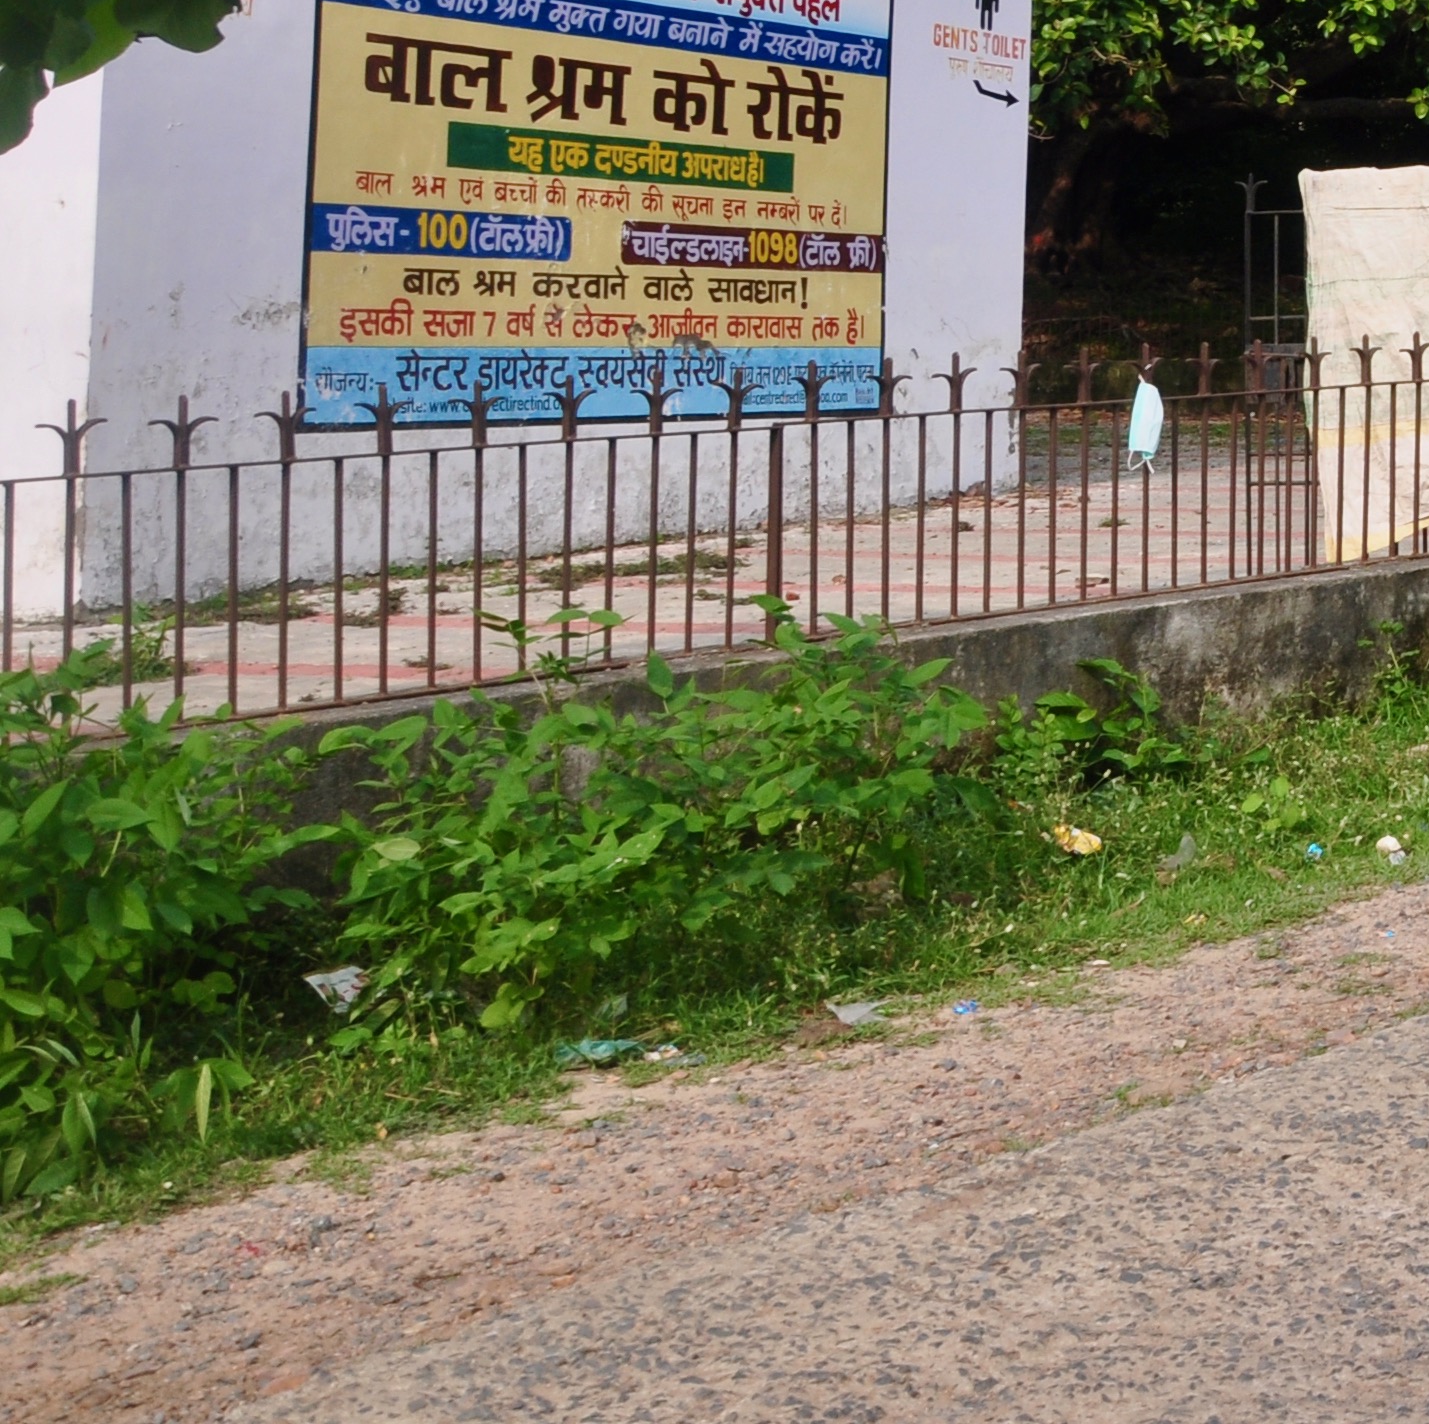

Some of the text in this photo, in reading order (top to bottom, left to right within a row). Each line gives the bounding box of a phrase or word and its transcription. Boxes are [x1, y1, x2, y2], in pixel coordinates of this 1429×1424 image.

[548, 0, 609, 33] मुक्त
[613, 9, 664, 39] गया
[668, 17, 734, 49] बनाने
[738, 21, 763, 53] में
[764, 30, 840, 61] सहयोग
[933, 23, 1026, 60] GENTS TOILET
[365, 33, 844, 144] बाल श्रम को रोकें
[508, 136, 544, 174] यह
[549, 139, 590, 173] एक
[594, 142, 678, 176] दण्डनीय
[356, 171, 394, 197] बाल
[411, 176, 446, 198] श्रम
[459, 177, 485, 205] एवं
[494, 177, 538, 205] बच्चों
[545, 178, 566, 206] की
[577, 184, 630, 214] तस्करी
[641, 185, 663, 213] की
[672, 193, 714, 222] सूचना
[723, 199, 746, 220] इन
[757, 196, 801, 224] नम्बरों
[808, 203, 825, 226] पर
[418, 212, 468, 250] 100
[403, 268, 460, 296] बाल
[473, 269, 516, 297] श्रम
[533, 266, 629, 301] करवाने
[643, 268, 694, 302] वाले
[339, 297, 414, 343] इसकी
[423, 309, 475, 338] सजा
[483, 311, 496, 336] 7
[507, 304, 536, 337] वर्ष
[727, 314, 803, 339] कारावास
[812, 316, 840, 342] तक
[396, 349, 469, 391] सेन्टर
[478, 348, 570, 391] डायरेक्ट
